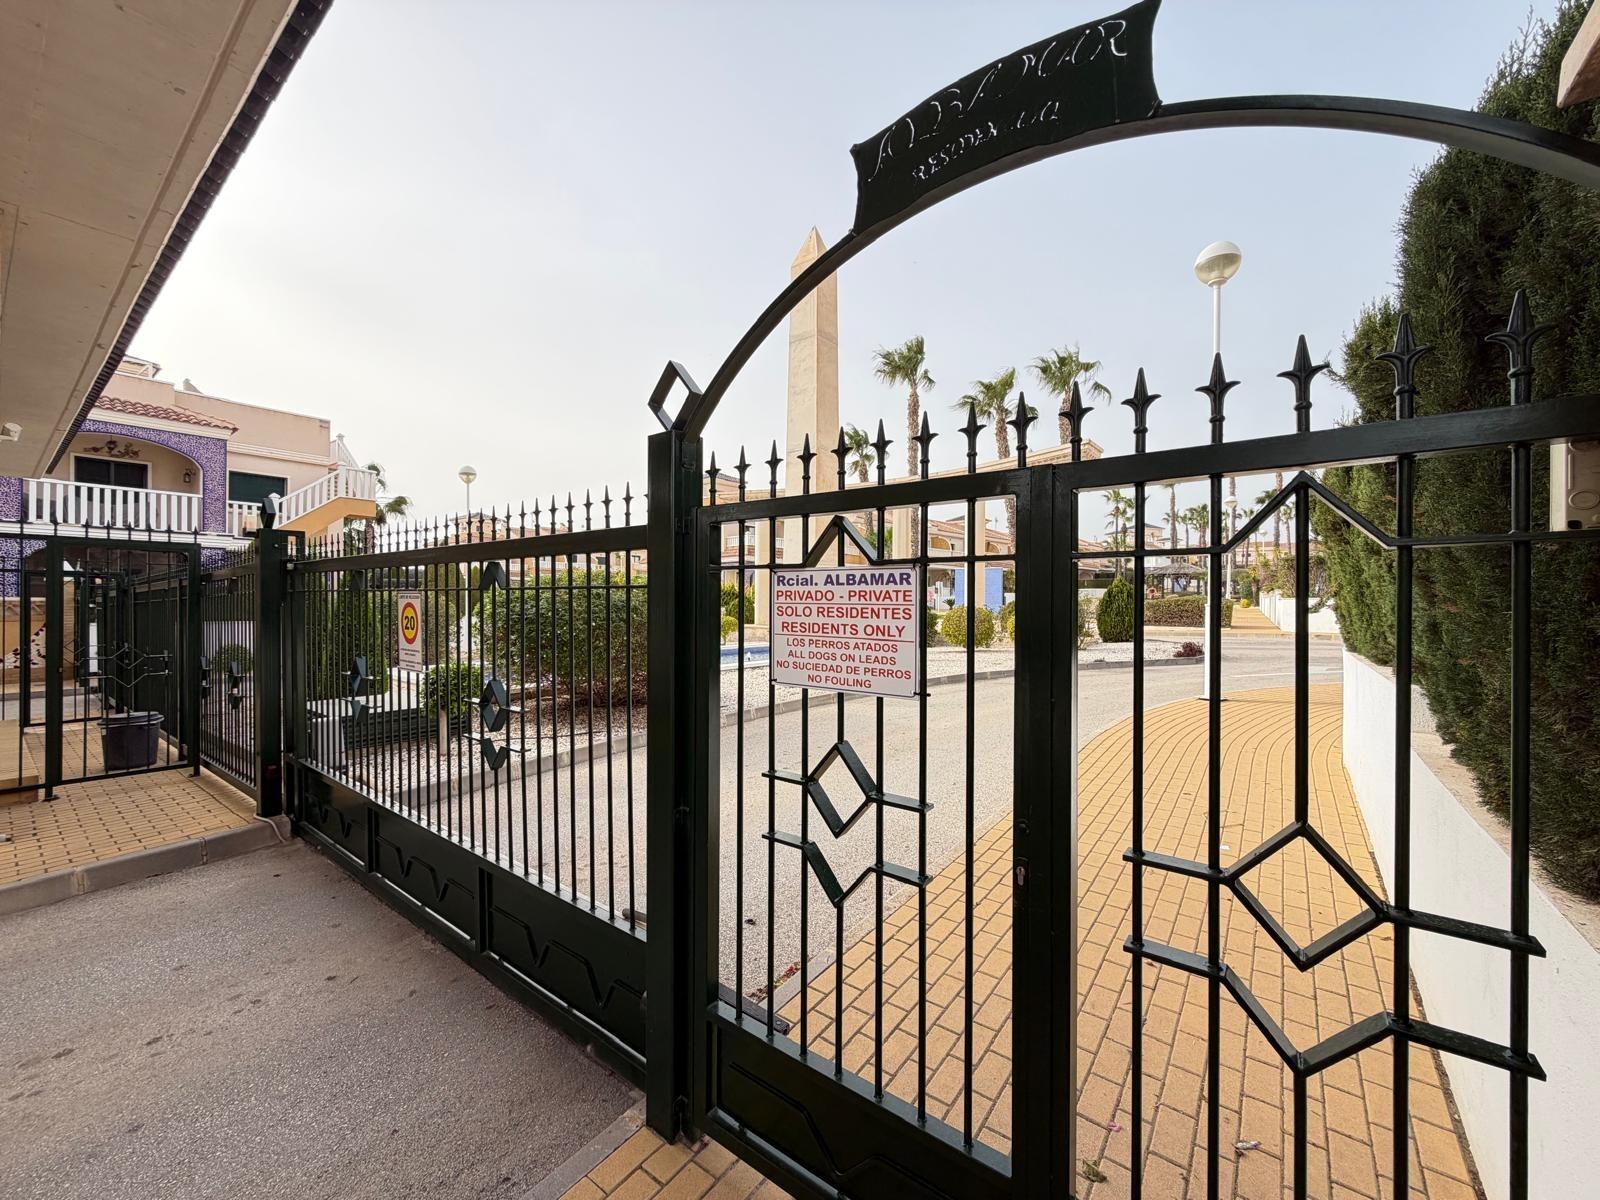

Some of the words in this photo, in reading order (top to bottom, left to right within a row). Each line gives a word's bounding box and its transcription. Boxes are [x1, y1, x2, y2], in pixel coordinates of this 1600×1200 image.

[776, 575, 818, 587] Rcial.
[824, 572, 912, 586] ALBAMAR
[776, 590, 834, 601] PRIVADO
[848, 590, 912, 602] PRIVATE
[776, 606, 812, 617] SOLO
[817, 606, 912, 620] RESIDENTES
[404, 616, 416, 631] 20
[782, 622, 858, 636] RESIDENTS
[864, 625, 905, 637] ONLY
[787, 638, 805, 647] LOS
[808, 639, 850, 650] PERROS
[853, 643, 898, 653] ATADOS
[788, 650, 805, 658] ALL
[809, 651, 837, 661] DOGS
[840, 654, 855, 662] ON
[859, 655, 896, 665] LEADS
[776, 660, 789, 668] NO
[792, 662, 842, 673] SUCIEDAD
[846, 666, 860, 674] DE
[864, 667, 911, 680] PERROS
[808, 674, 822, 683] NO
[825, 676, 871, 688] FOULING
